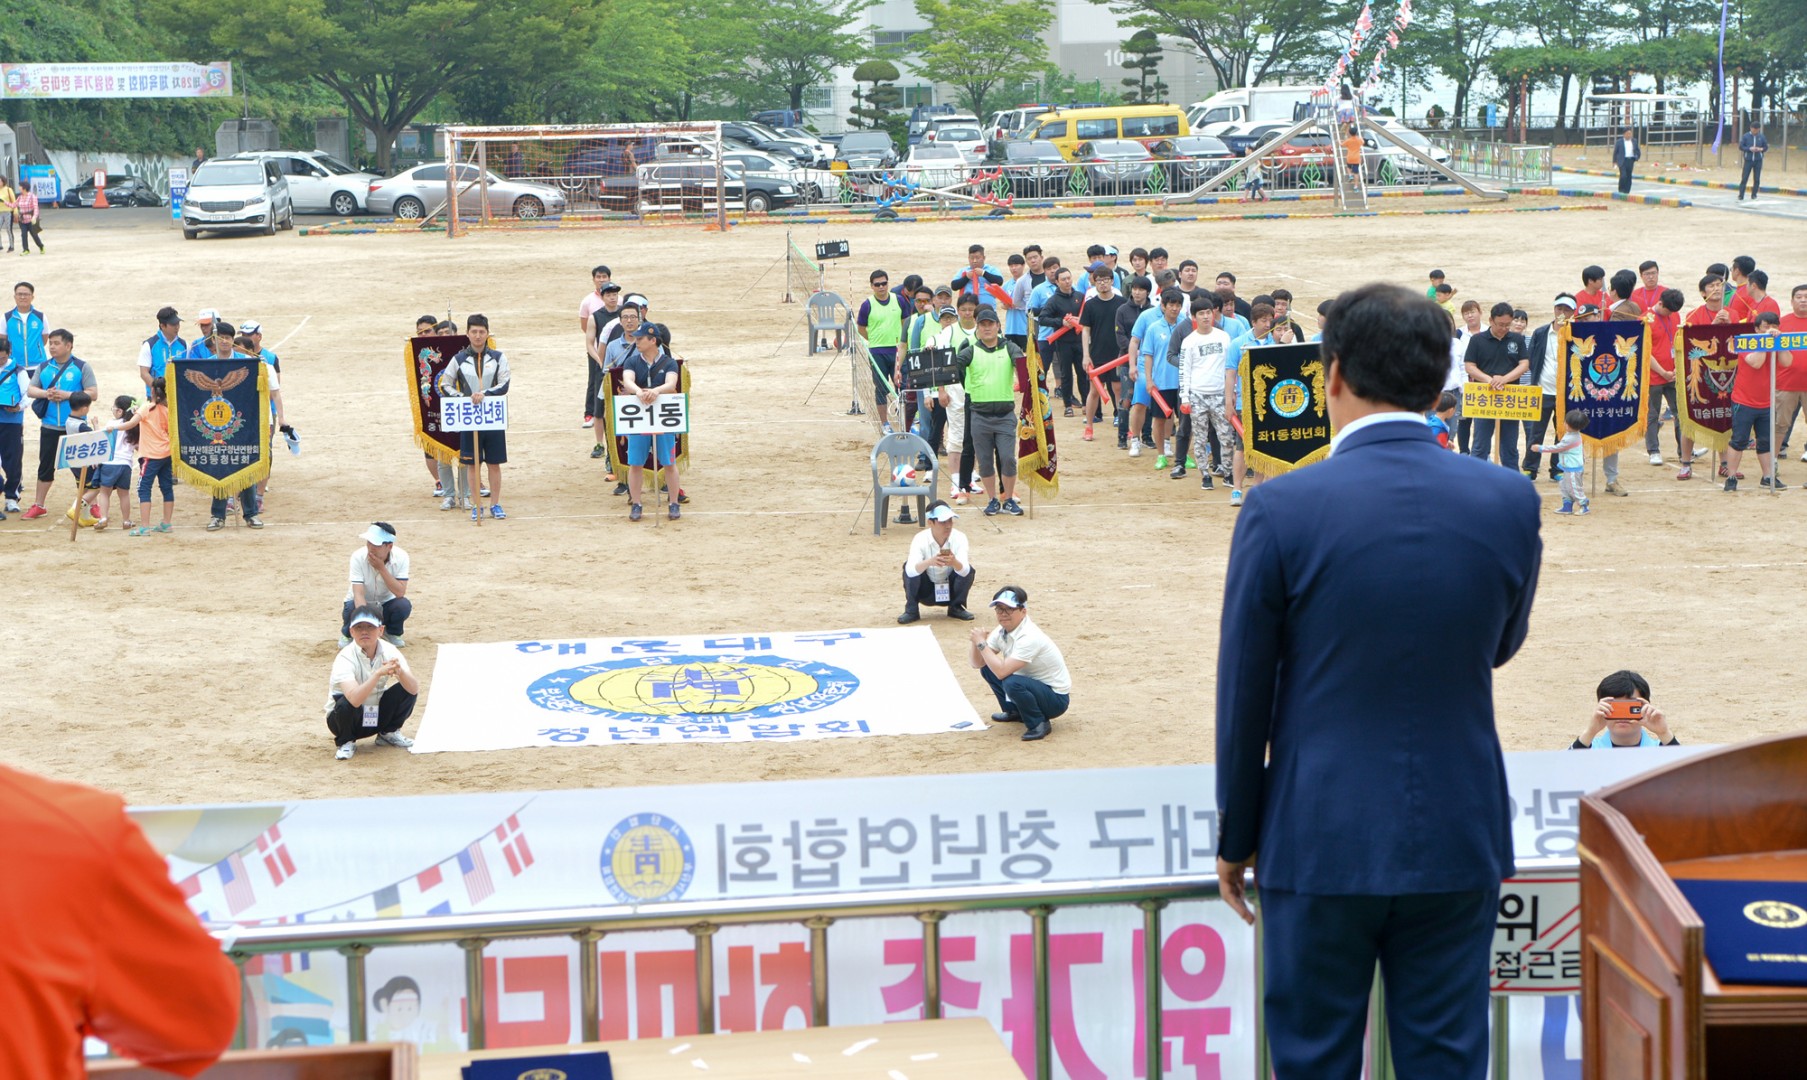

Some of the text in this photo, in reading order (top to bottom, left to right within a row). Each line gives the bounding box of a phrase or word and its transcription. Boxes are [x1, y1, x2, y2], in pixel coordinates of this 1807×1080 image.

[817, 245, 826, 255] 11
[839, 242, 848, 252] 20
[1737, 337, 1774, 350] 재송1동
[908, 351, 953, 370] 14 7
[1465, 392, 1540, 410] 반송1동청년회
[619, 402, 683, 428] 우1동
[1578, 406, 1634, 418] 송1동청년회
[1693, 407, 1732, 420] 재송1동청
[1257, 426, 1326, 442] 좌1동청년회
[65, 439, 108, 461] 반송2동
[188, 455, 250, 465] 좌3동청년회
[538, 719, 871, 742] 청년연합회
[1495, 893, 1539, 942] 위
[1495, 951, 1581, 980] 접근금
